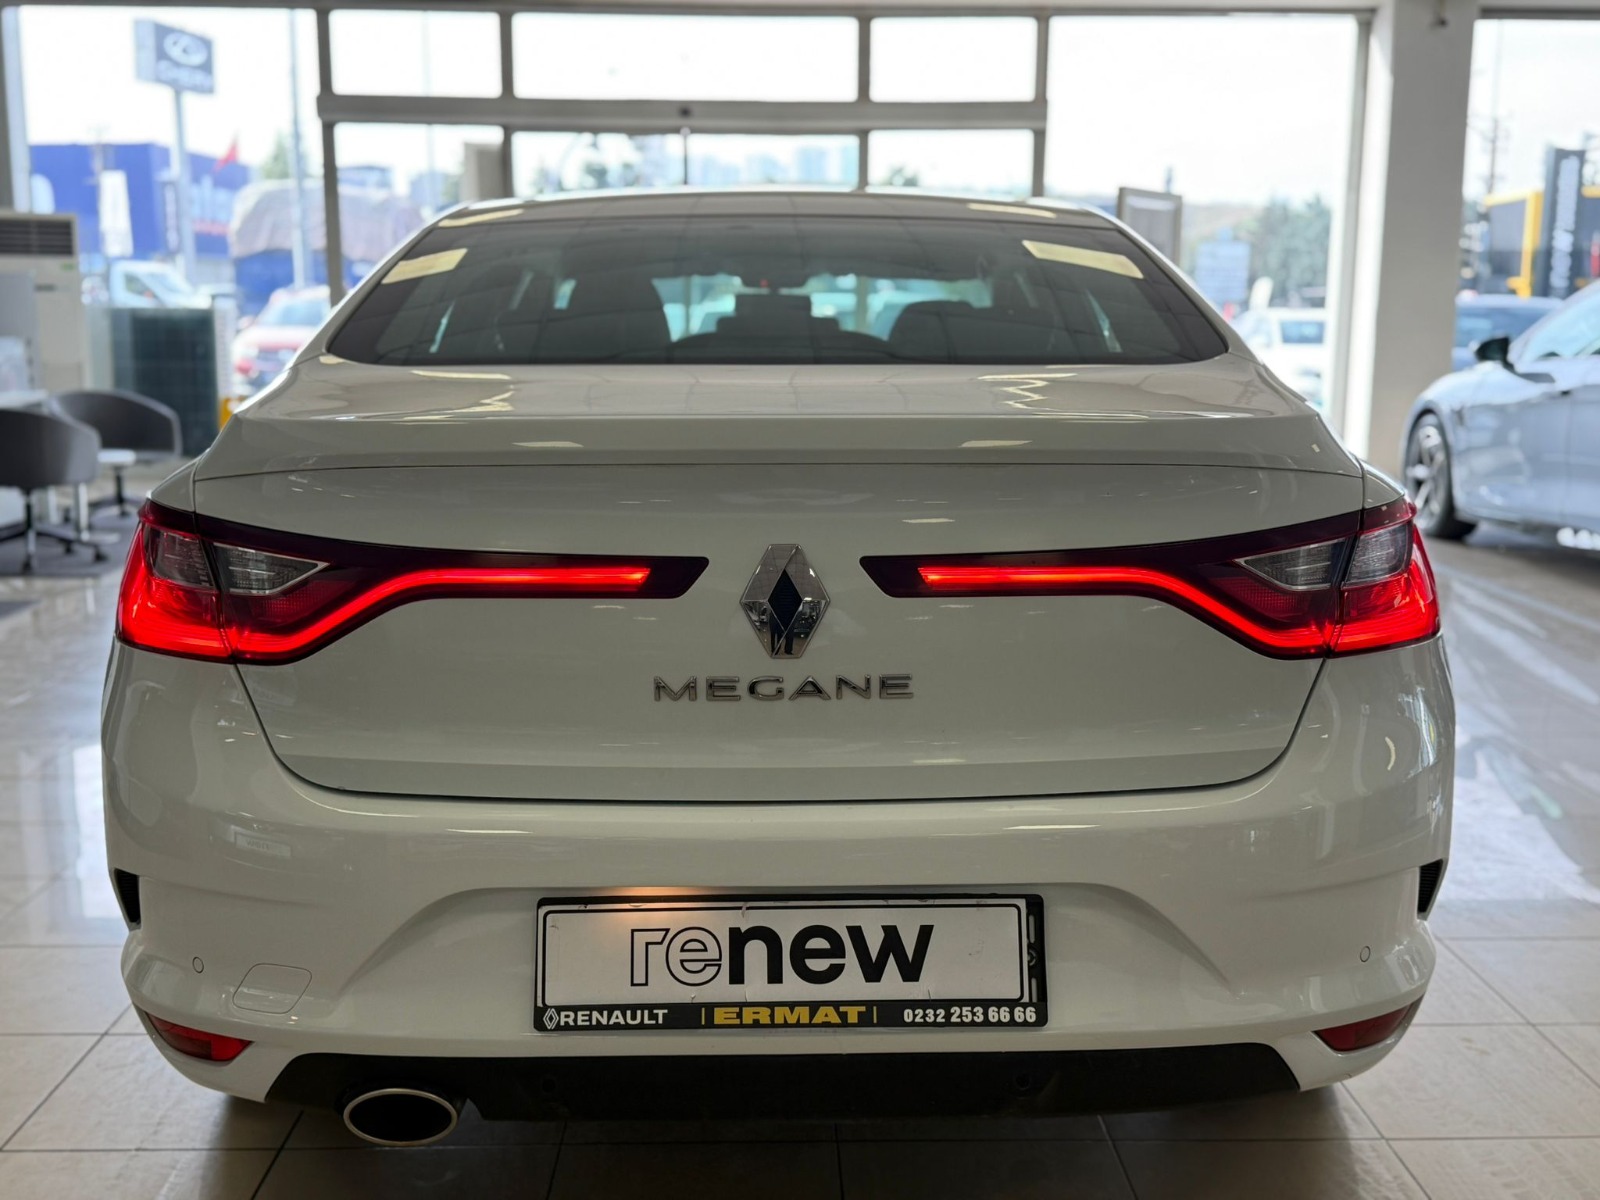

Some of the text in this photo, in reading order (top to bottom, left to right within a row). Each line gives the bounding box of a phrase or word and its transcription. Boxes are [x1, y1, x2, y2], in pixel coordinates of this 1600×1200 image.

[653, 674, 914, 701] MEGANE
[630, 924, 935, 987] renew
[559, 1009, 669, 1026] RENAULT
[713, 1006, 866, 1025] ERMAT
[903, 1006, 1037, 1023] 0232 253 66 66
